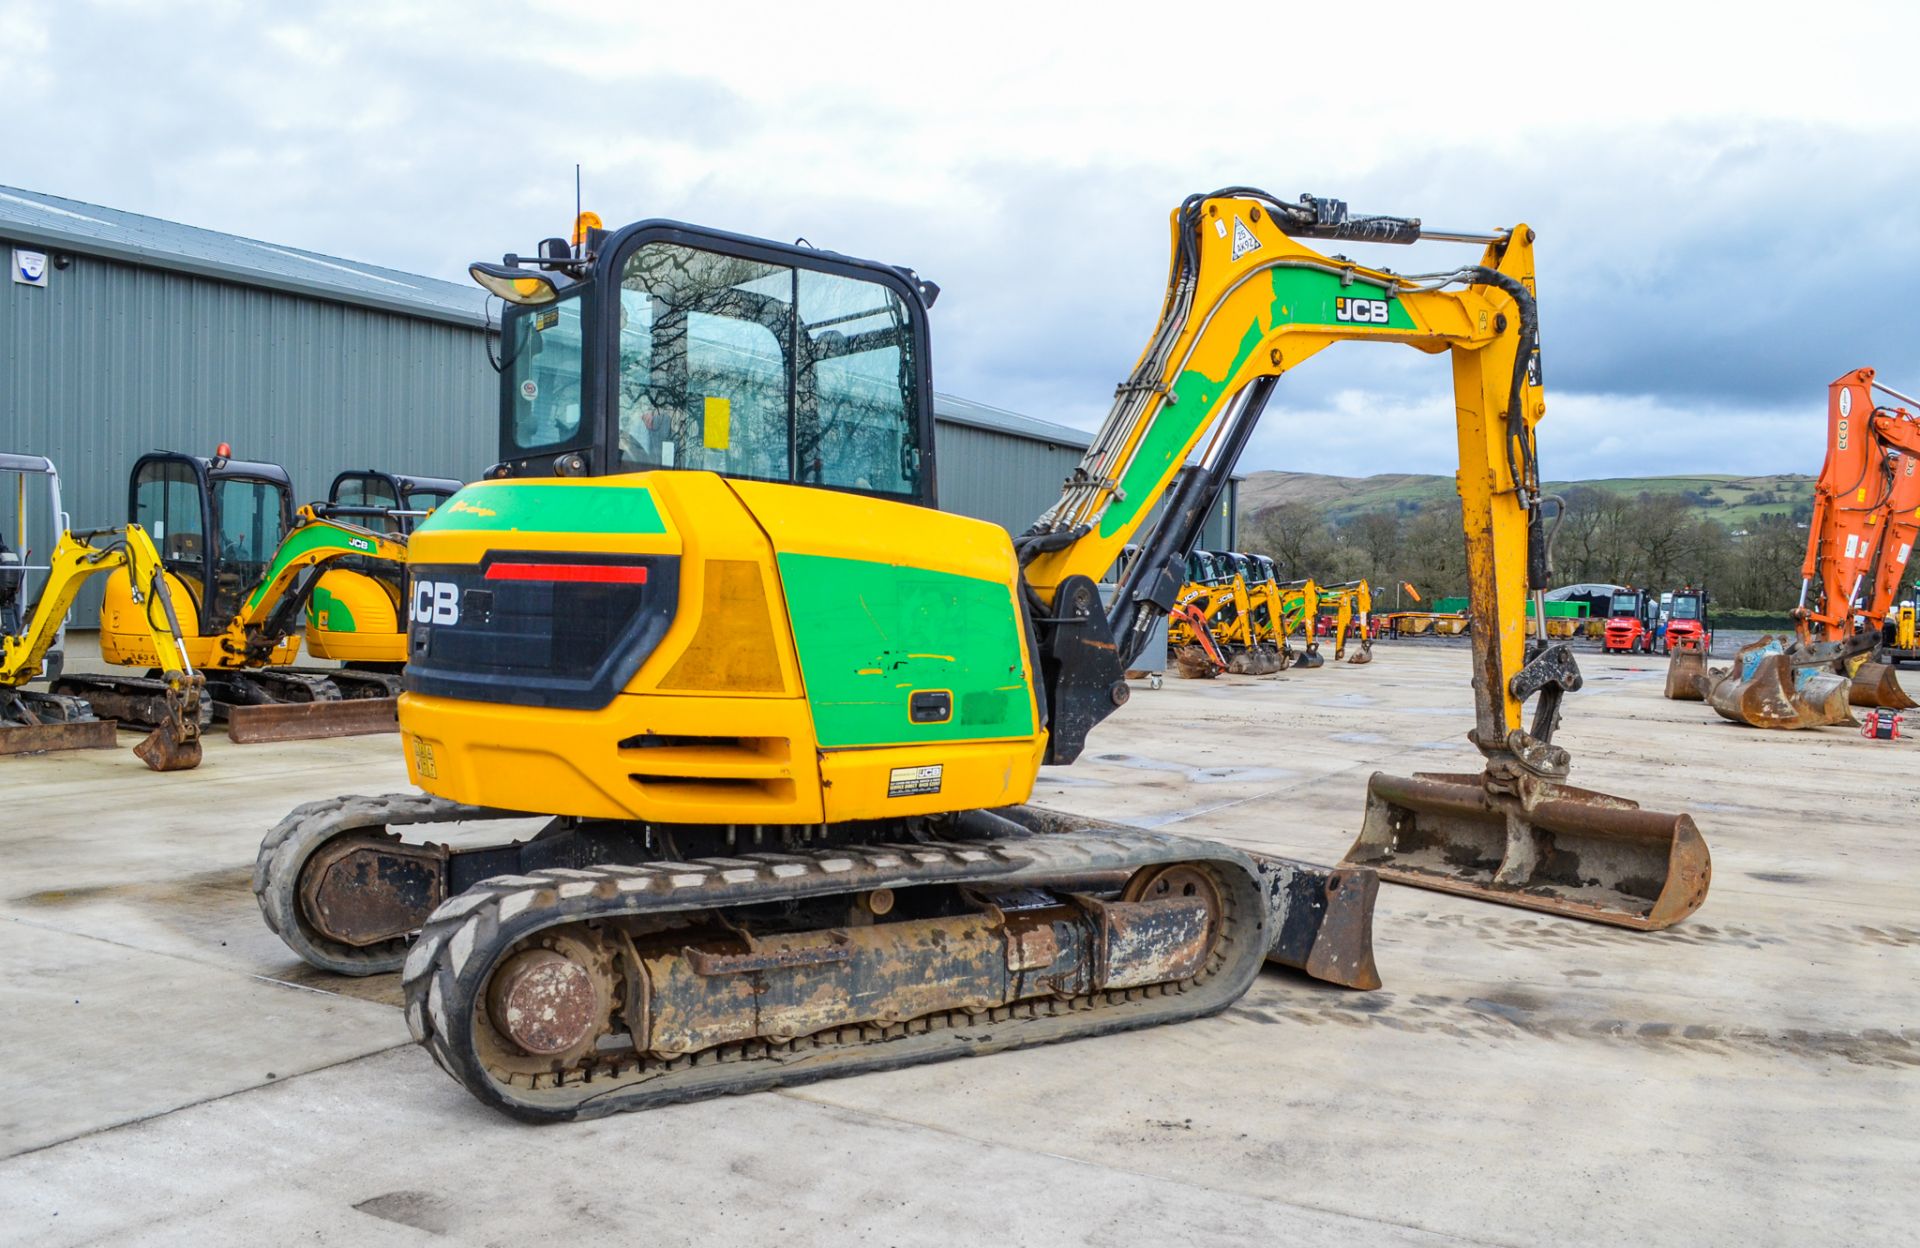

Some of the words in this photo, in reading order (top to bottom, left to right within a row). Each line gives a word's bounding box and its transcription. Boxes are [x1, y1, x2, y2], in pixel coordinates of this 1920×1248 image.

[1237, 230, 1246, 241] 25
[1336, 297, 1389, 323] JCB
[1838, 421, 1848, 450] eco
[348, 537, 369, 550] JCB
[409, 580, 460, 626] JCB
[1181, 590, 1199, 606] JCB
[1218, 592, 1234, 604] JCB
[918, 766, 941, 778] JCB
